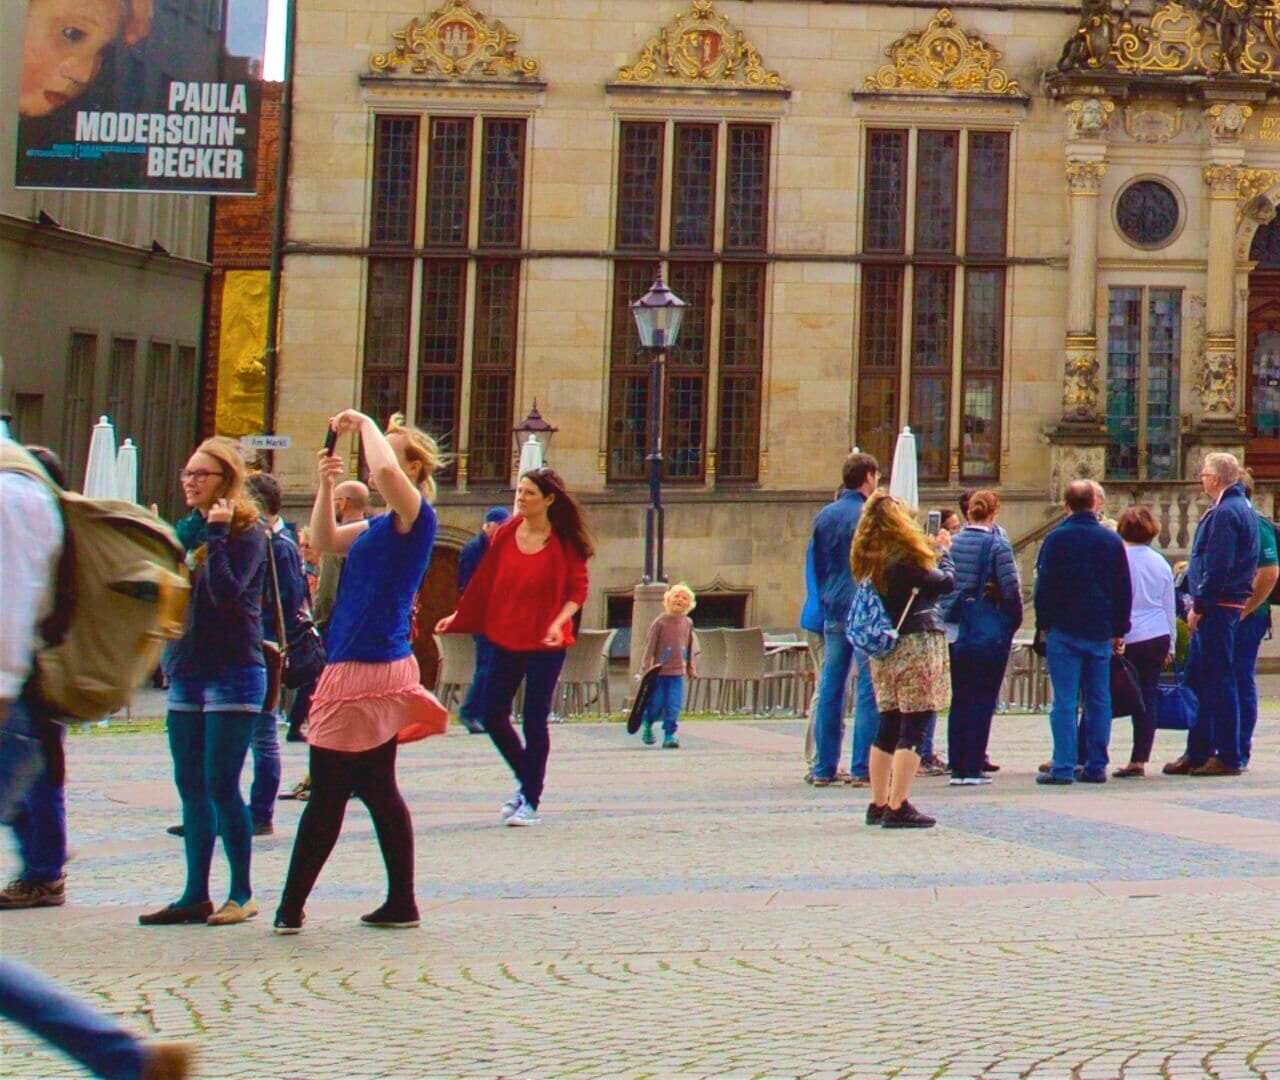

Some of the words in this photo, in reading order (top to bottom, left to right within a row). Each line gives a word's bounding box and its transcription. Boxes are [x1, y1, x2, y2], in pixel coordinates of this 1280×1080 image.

[168, 81, 248, 114] PAULA
[75, 110, 246, 146] MODERSOHN-
[147, 147, 243, 179] BECKER
[252, 438, 264, 446] Am
[266, 438, 287, 447] Markt
